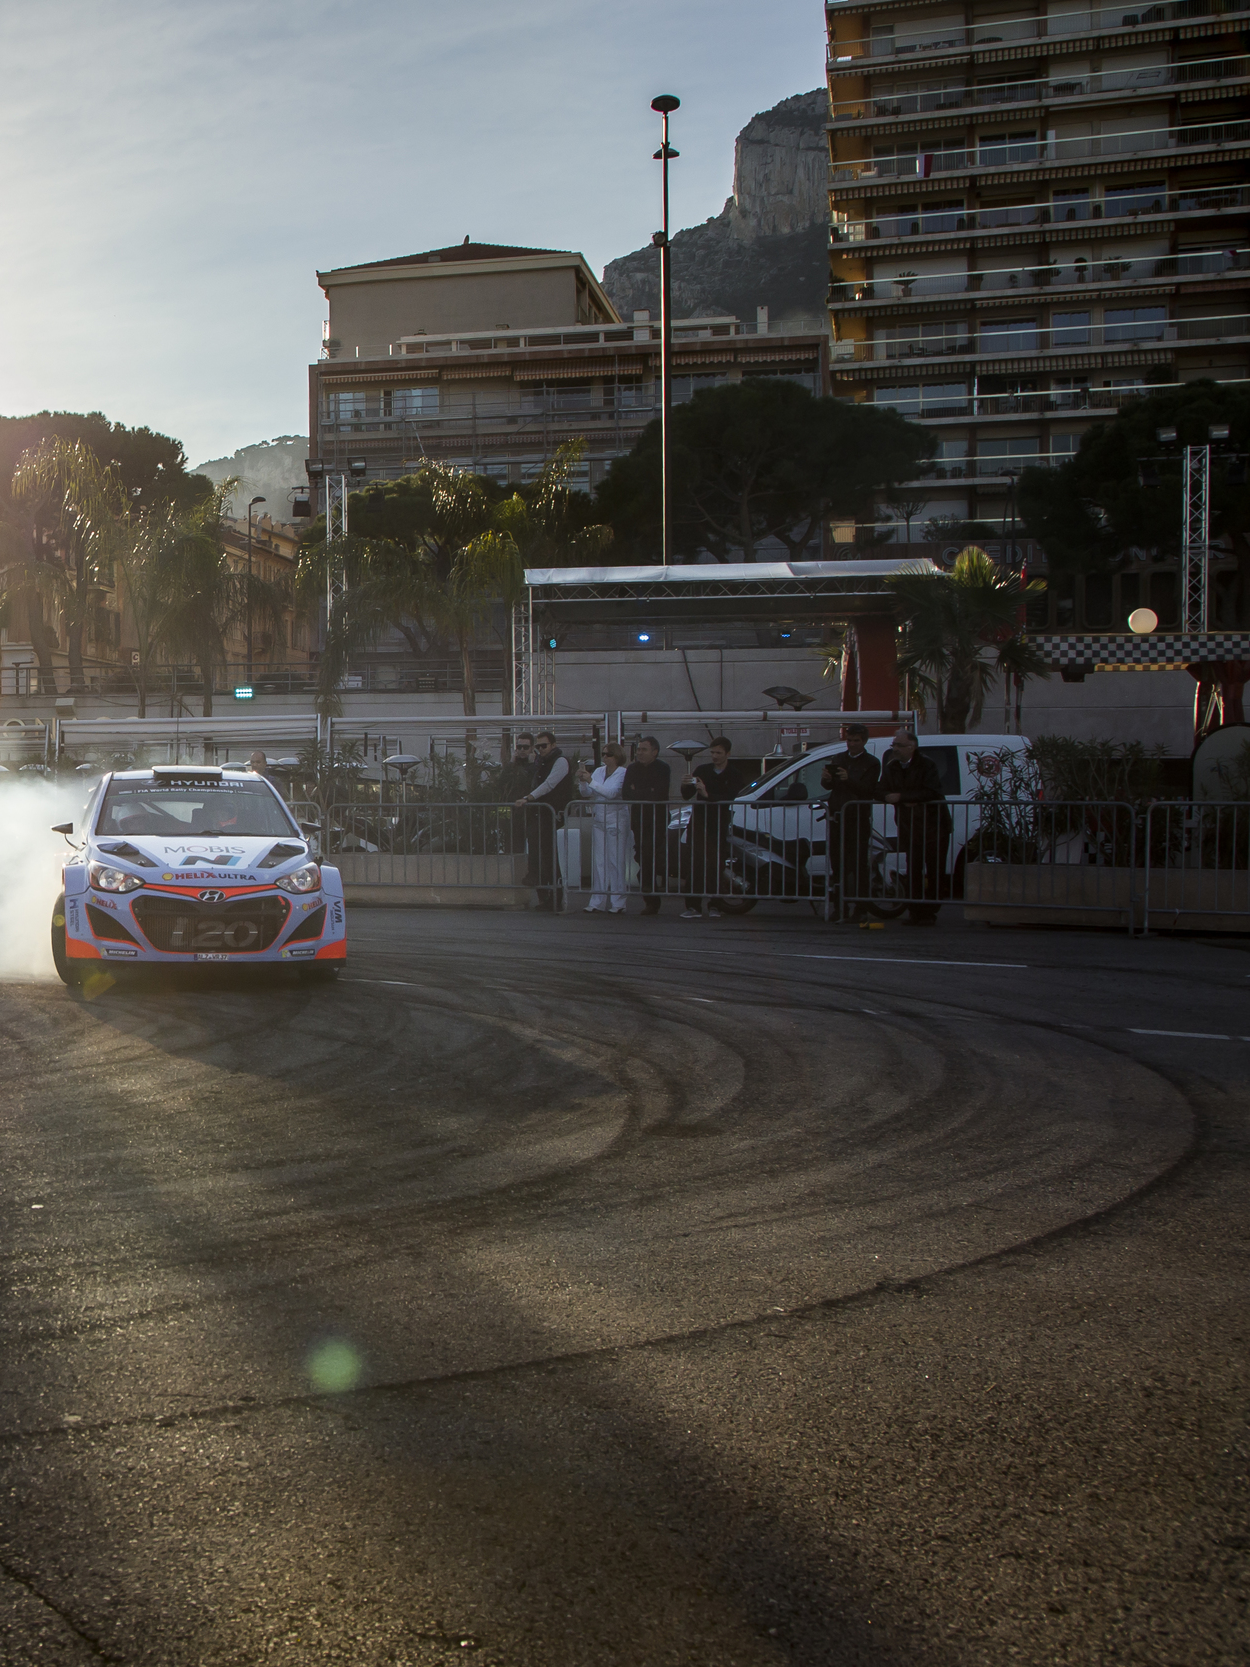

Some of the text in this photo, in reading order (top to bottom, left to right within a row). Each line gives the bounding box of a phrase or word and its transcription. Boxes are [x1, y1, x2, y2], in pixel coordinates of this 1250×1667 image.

[942, 545, 1048, 566] CEDIT
[164, 845, 246, 854] MOBIS
[175, 870, 257, 881] HELIX ULTRA
